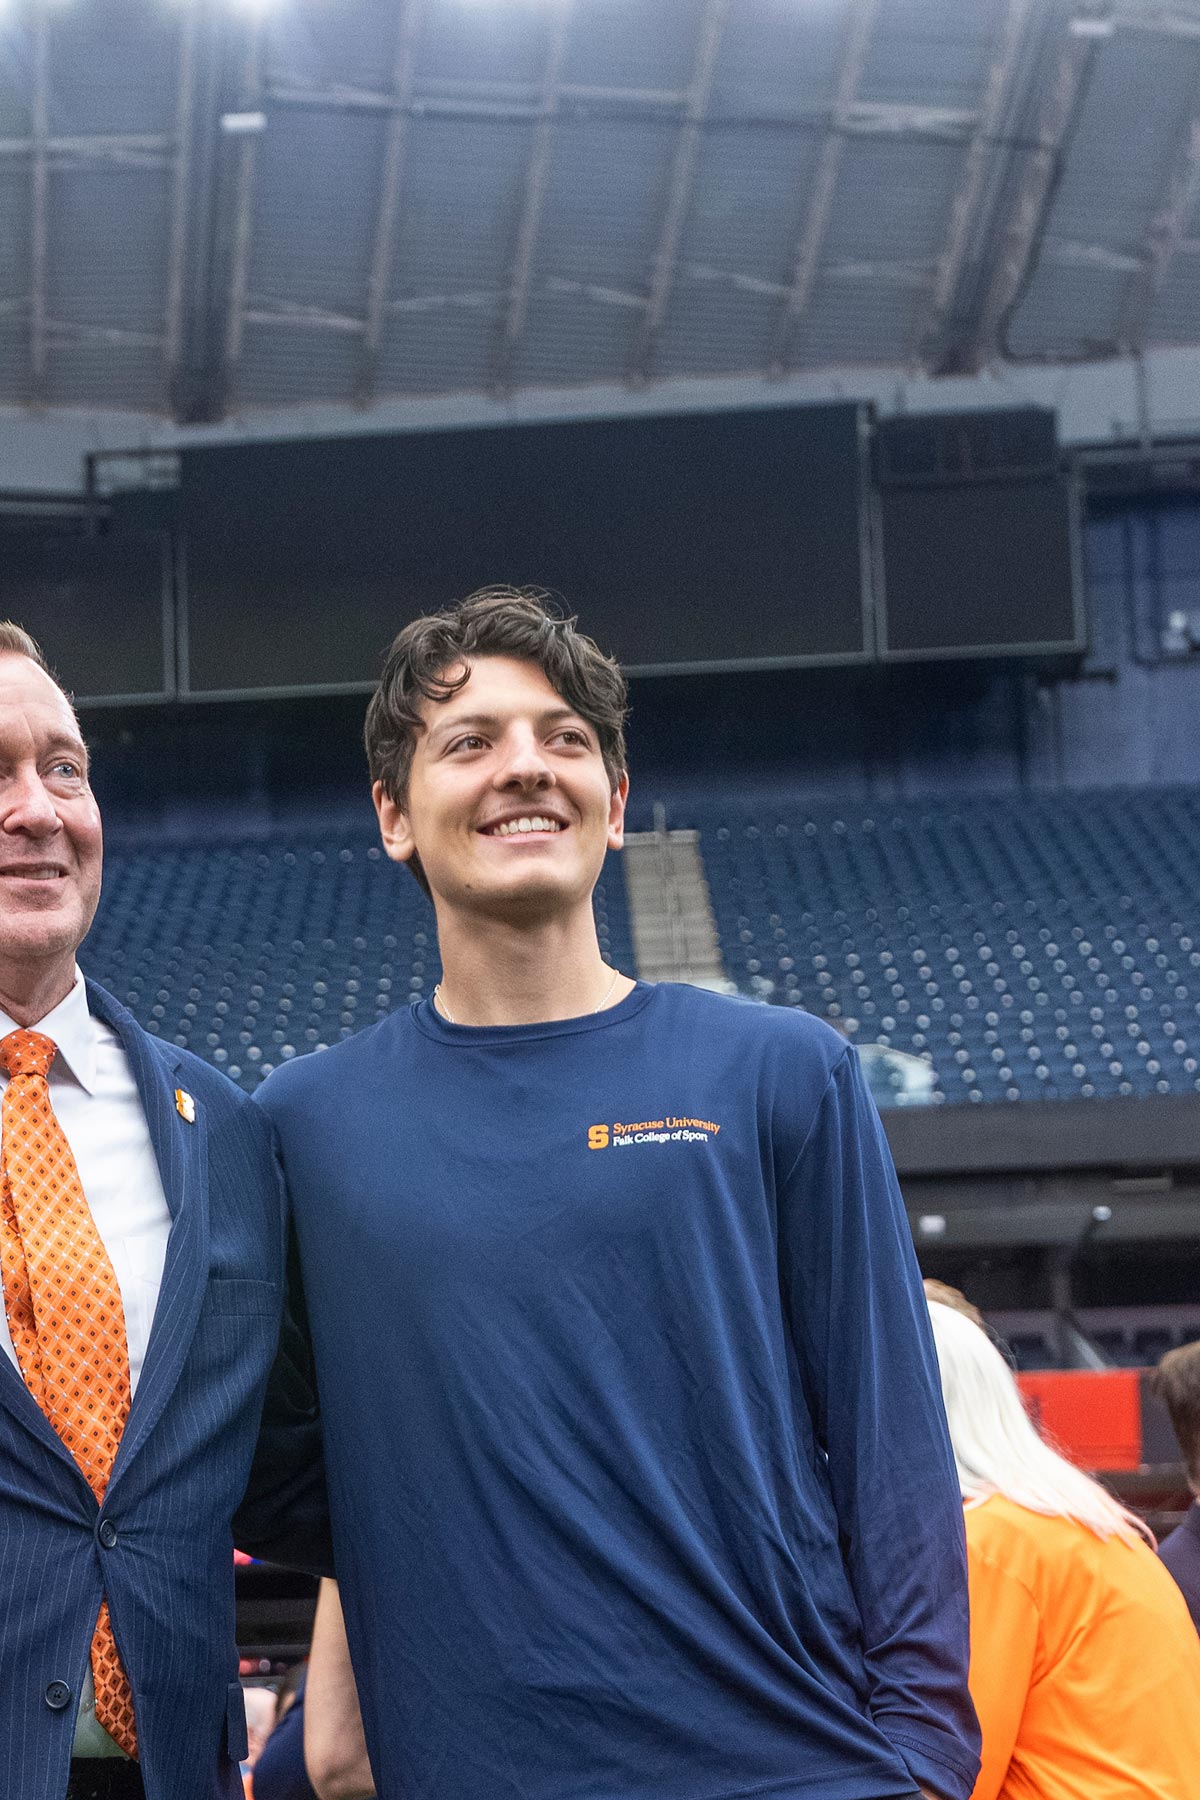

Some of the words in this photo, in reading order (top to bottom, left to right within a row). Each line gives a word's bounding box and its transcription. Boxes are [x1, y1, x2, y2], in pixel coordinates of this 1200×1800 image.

[613, 1120, 664, 1136] Syracuse
[666, 1117, 721, 1135] University
[588, 1124, 610, 1149] S
[613, 1134, 633, 1147] Falk
[634, 1131, 671, 1144] College
[671, 1130, 683, 1141] of
[683, 1129, 708, 1143] Sport
